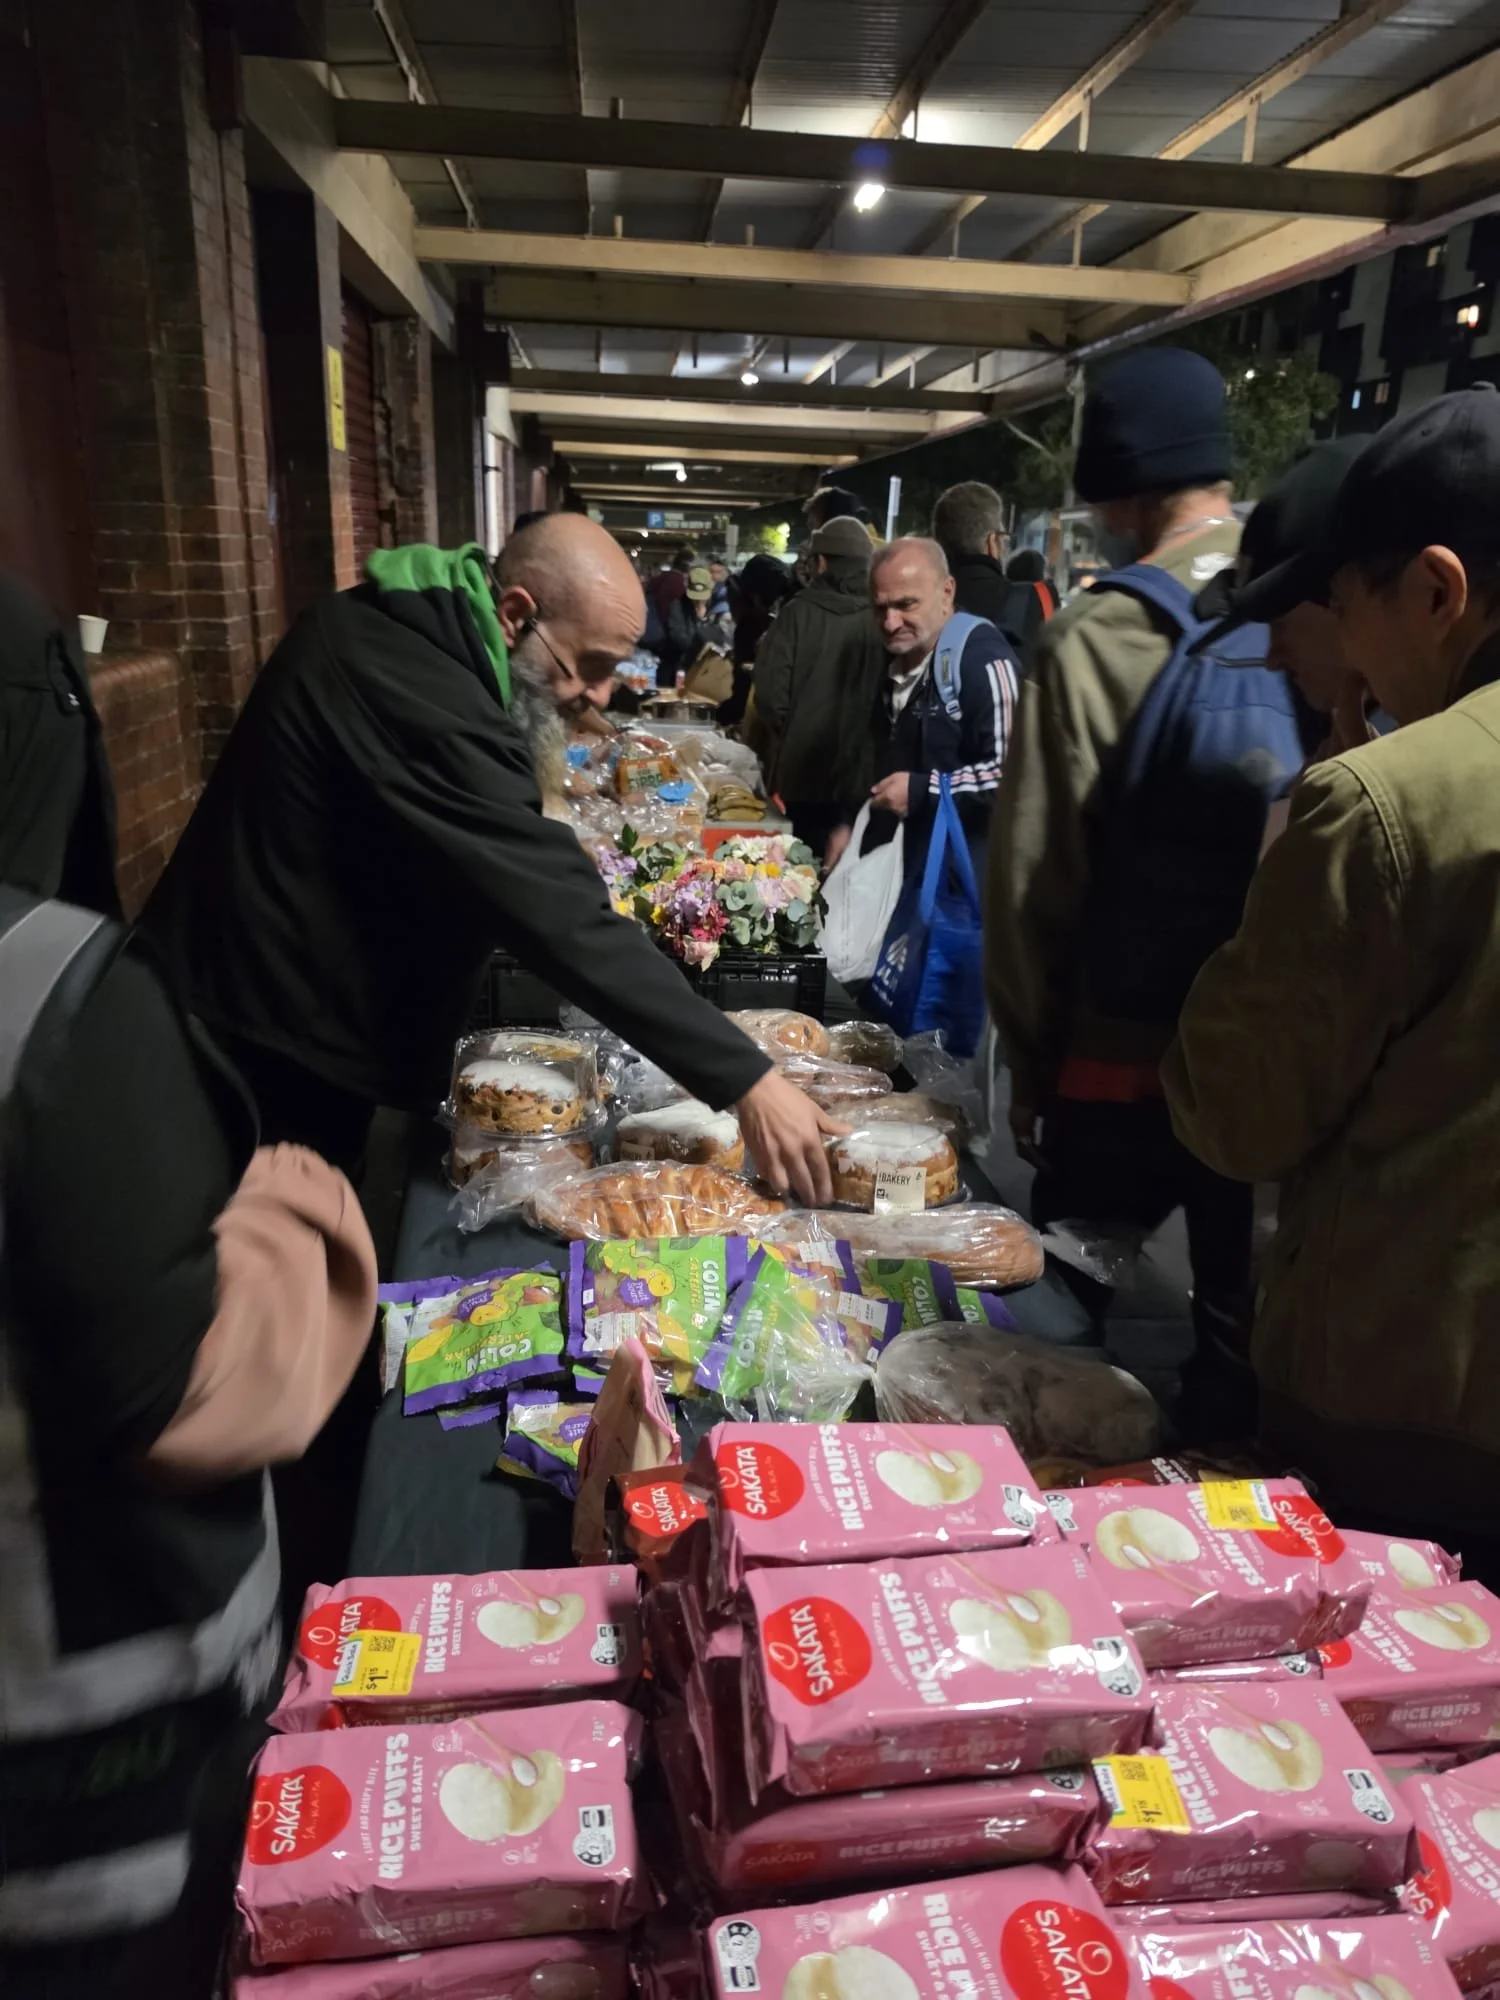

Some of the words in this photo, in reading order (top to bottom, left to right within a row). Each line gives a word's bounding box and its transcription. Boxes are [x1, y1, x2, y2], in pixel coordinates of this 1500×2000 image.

[881, 1171, 911, 1185] BAKERY
[818, 1424, 851, 1486] PUFFS
[846, 1443, 861, 1470] SALTY
[736, 1446, 767, 1515] SAKATA
[856, 1479, 873, 1511] SWEET
[651, 1486, 679, 1532] SAKATA
[834, 1486, 864, 1531] RICE
[1215, 1532, 1266, 1586] PUFFS
[428, 1581, 452, 1636] PUFFS
[879, 1572, 925, 1648] PUFFS
[423, 1636, 448, 1673] RICE
[790, 1604, 834, 1697] SAKATA
[1374, 1636, 1418, 1673] RICE
[1391, 1706, 1430, 1722] RICE
[1431, 1701, 1481, 1717] PUFFS
[1173, 1720, 1194, 1750] SALTY
[382, 1732, 409, 1819] PUFFS
[412, 1756, 424, 1794] SALTY
[1173, 1770, 1216, 1824] RICE
[1193, 1761, 1219, 1797] SWEET
[270, 1774, 305, 1856] SAKATA
[410, 1806, 422, 1852] SWEET
[378, 1819, 406, 1880] RICE
[839, 1843, 894, 1859] RICE
[896, 1834, 970, 1852] PUFFS
[1220, 1859, 1287, 1876] PUFFS
[416, 1908, 496, 1931] PUFFS
[923, 1893, 968, 1966] RICE
[960, 1921, 984, 1949] LIGHT
[915, 1930, 943, 1979] SWEET
[1035, 1908, 1093, 2000] SAKAT
